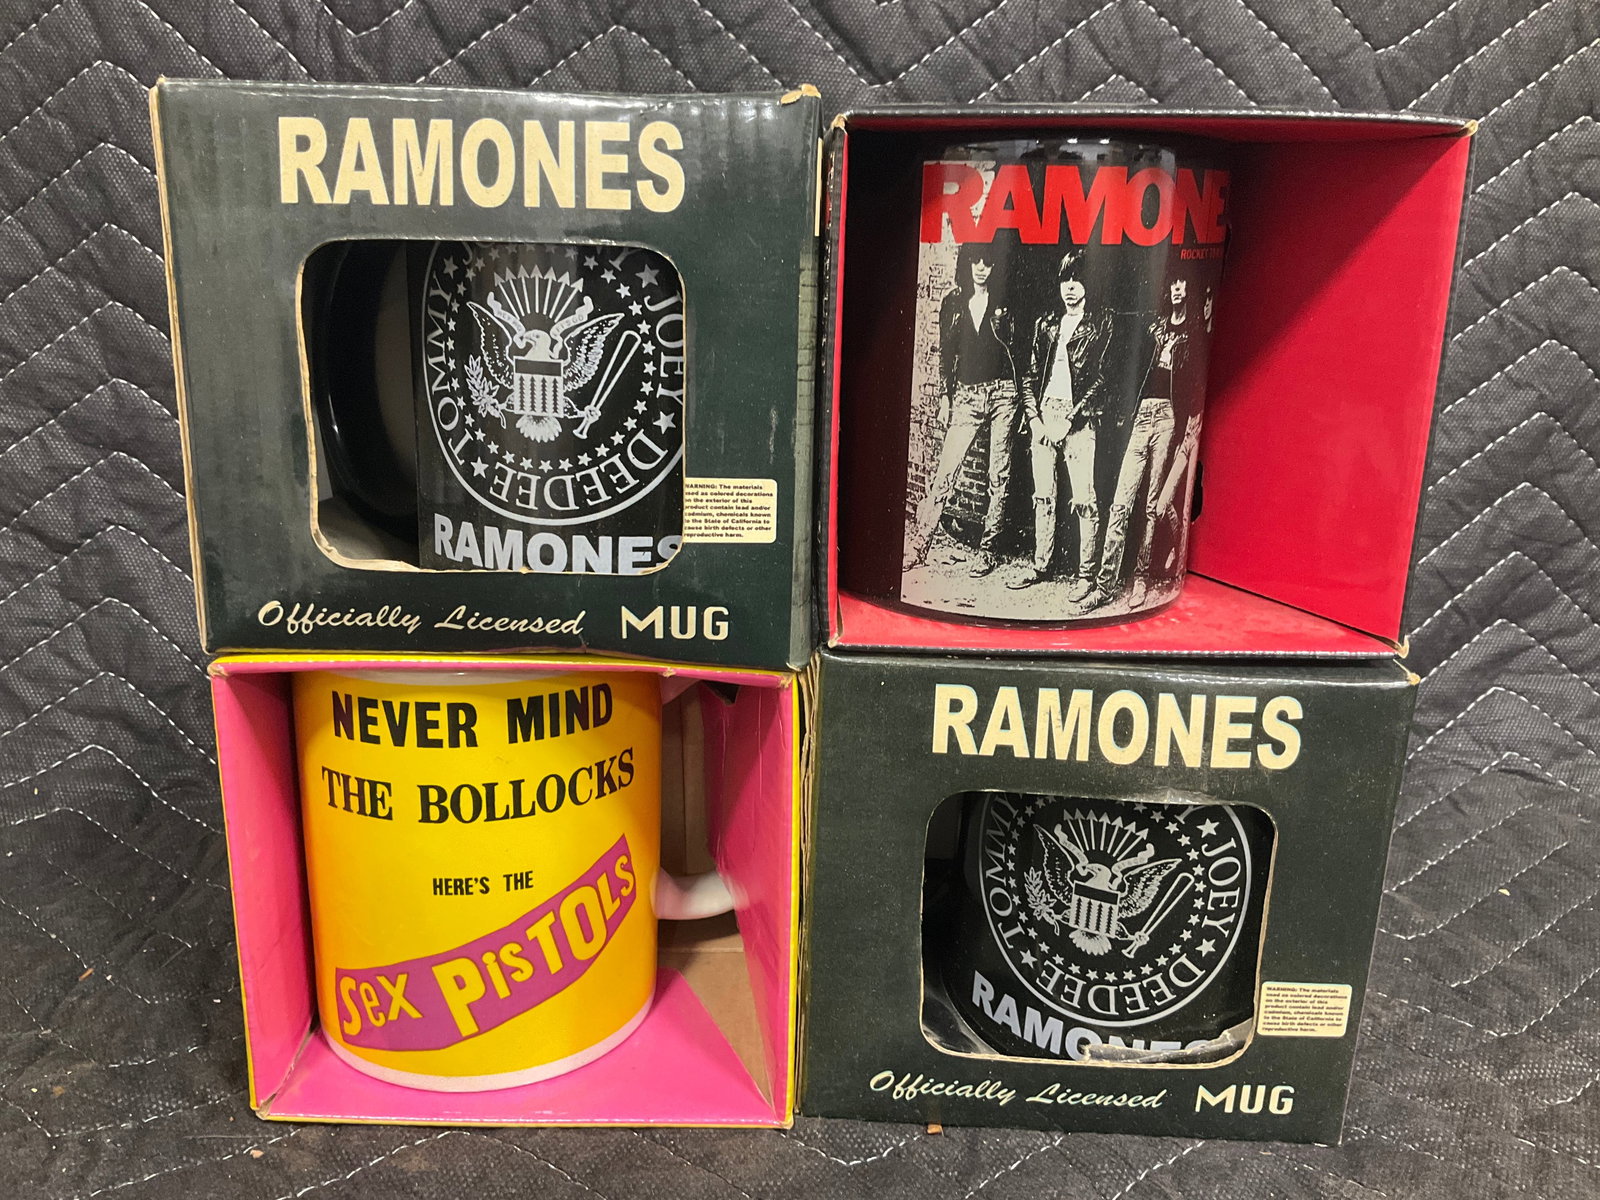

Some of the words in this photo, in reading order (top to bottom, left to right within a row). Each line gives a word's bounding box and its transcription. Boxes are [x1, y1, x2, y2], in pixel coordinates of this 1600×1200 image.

[278, 116, 686, 213] RAMONES
[428, 272, 475, 465] TOMMY
[490, 428, 669, 511] DEEDEE
[258, 600, 422, 634] Officially
[434, 606, 585, 636] Licensed
[621, 605, 730, 641] MUG
[332, 690, 478, 749] NEVER
[507, 683, 613, 744] MIND
[932, 683, 1305, 771] RAMONES
[321, 766, 393, 821] THE
[417, 747, 635, 824] BOLLOCKS
[432, 876, 490, 896] HERE'S
[503, 870, 534, 893] THE
[1201, 837, 1242, 938] JOEY
[972, 970, 1213, 1061] RAMO
[1036, 953, 1206, 1015] DEEDEE
[869, 1070, 1016, 1105] Officially
[1026, 1083, 1167, 1109] Licensed
[1195, 1084, 1295, 1115] MUG
